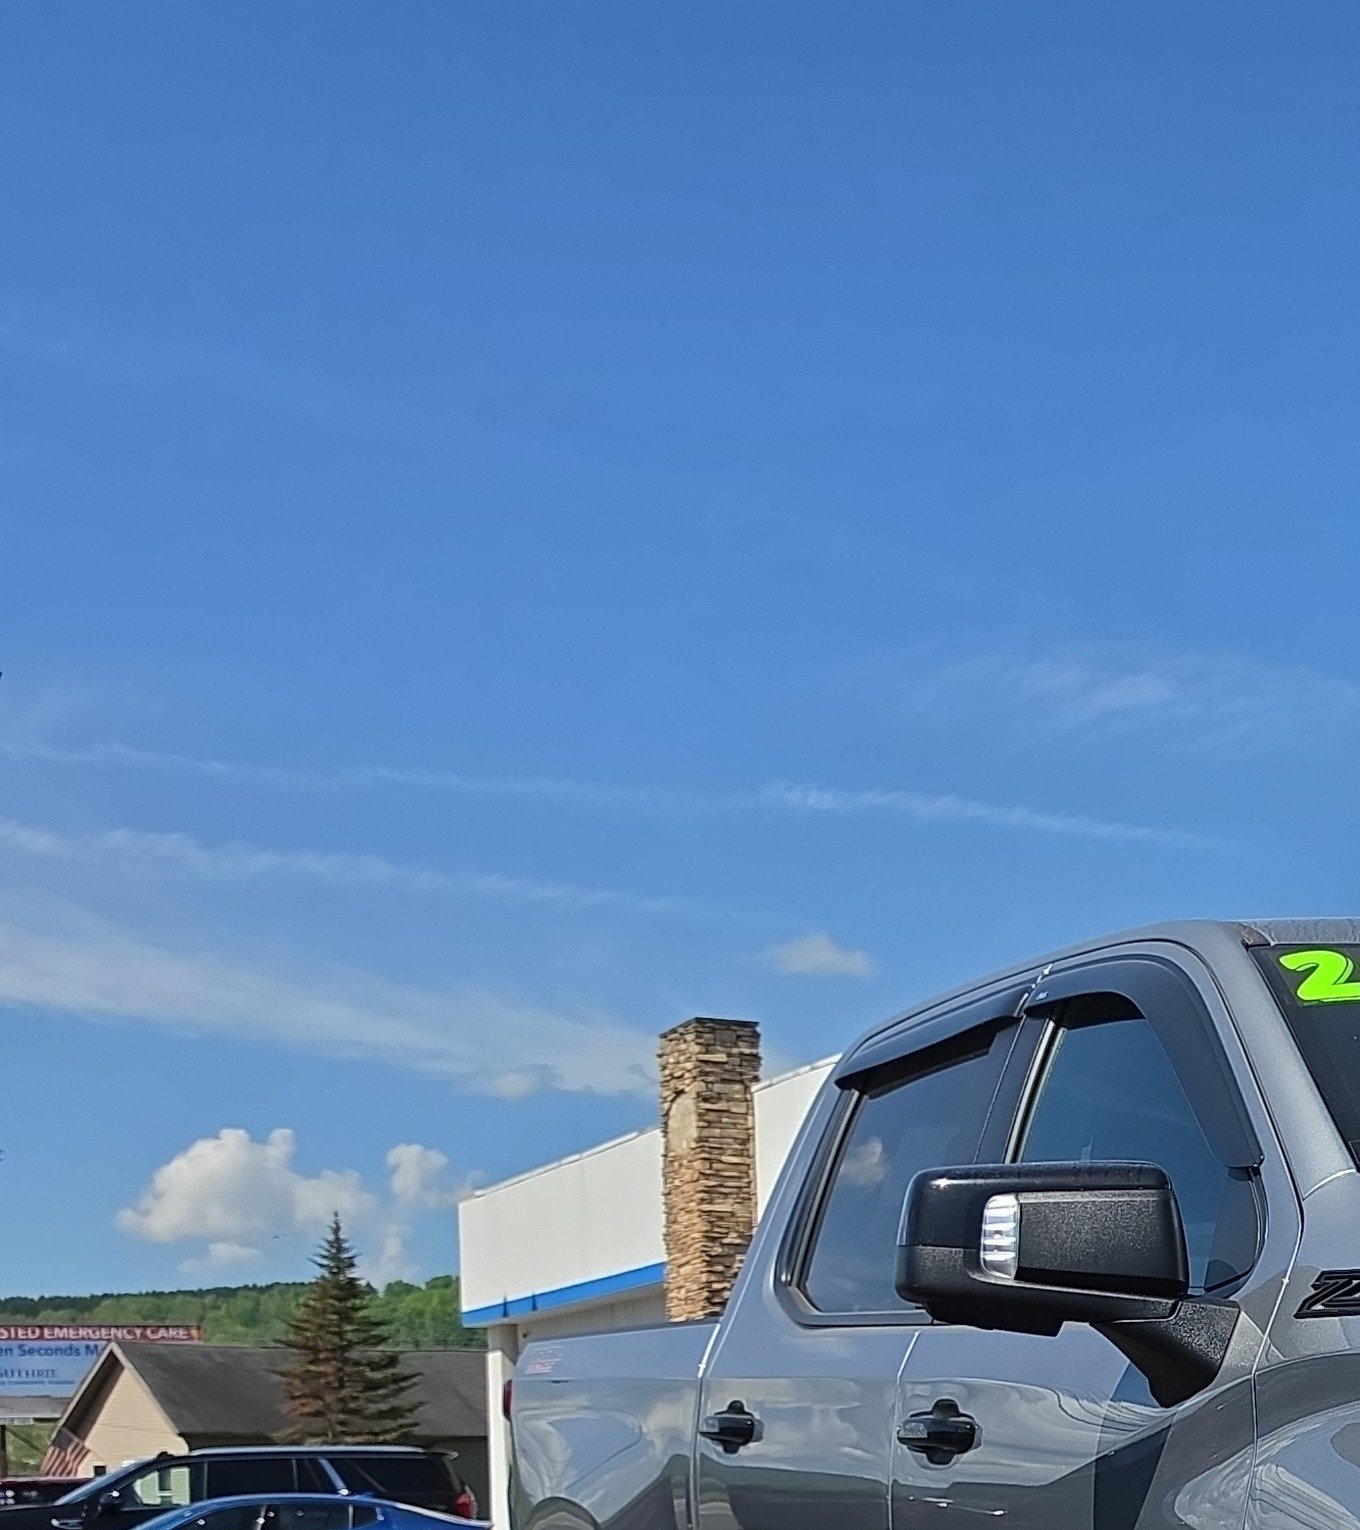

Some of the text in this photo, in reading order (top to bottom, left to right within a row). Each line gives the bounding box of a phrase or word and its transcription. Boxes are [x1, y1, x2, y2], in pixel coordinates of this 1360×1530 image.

[44, 1327, 142, 1340] EMERGENCY
[147, 1328, 190, 1340] CARE
[17, 1344, 81, 1357] Seconds
